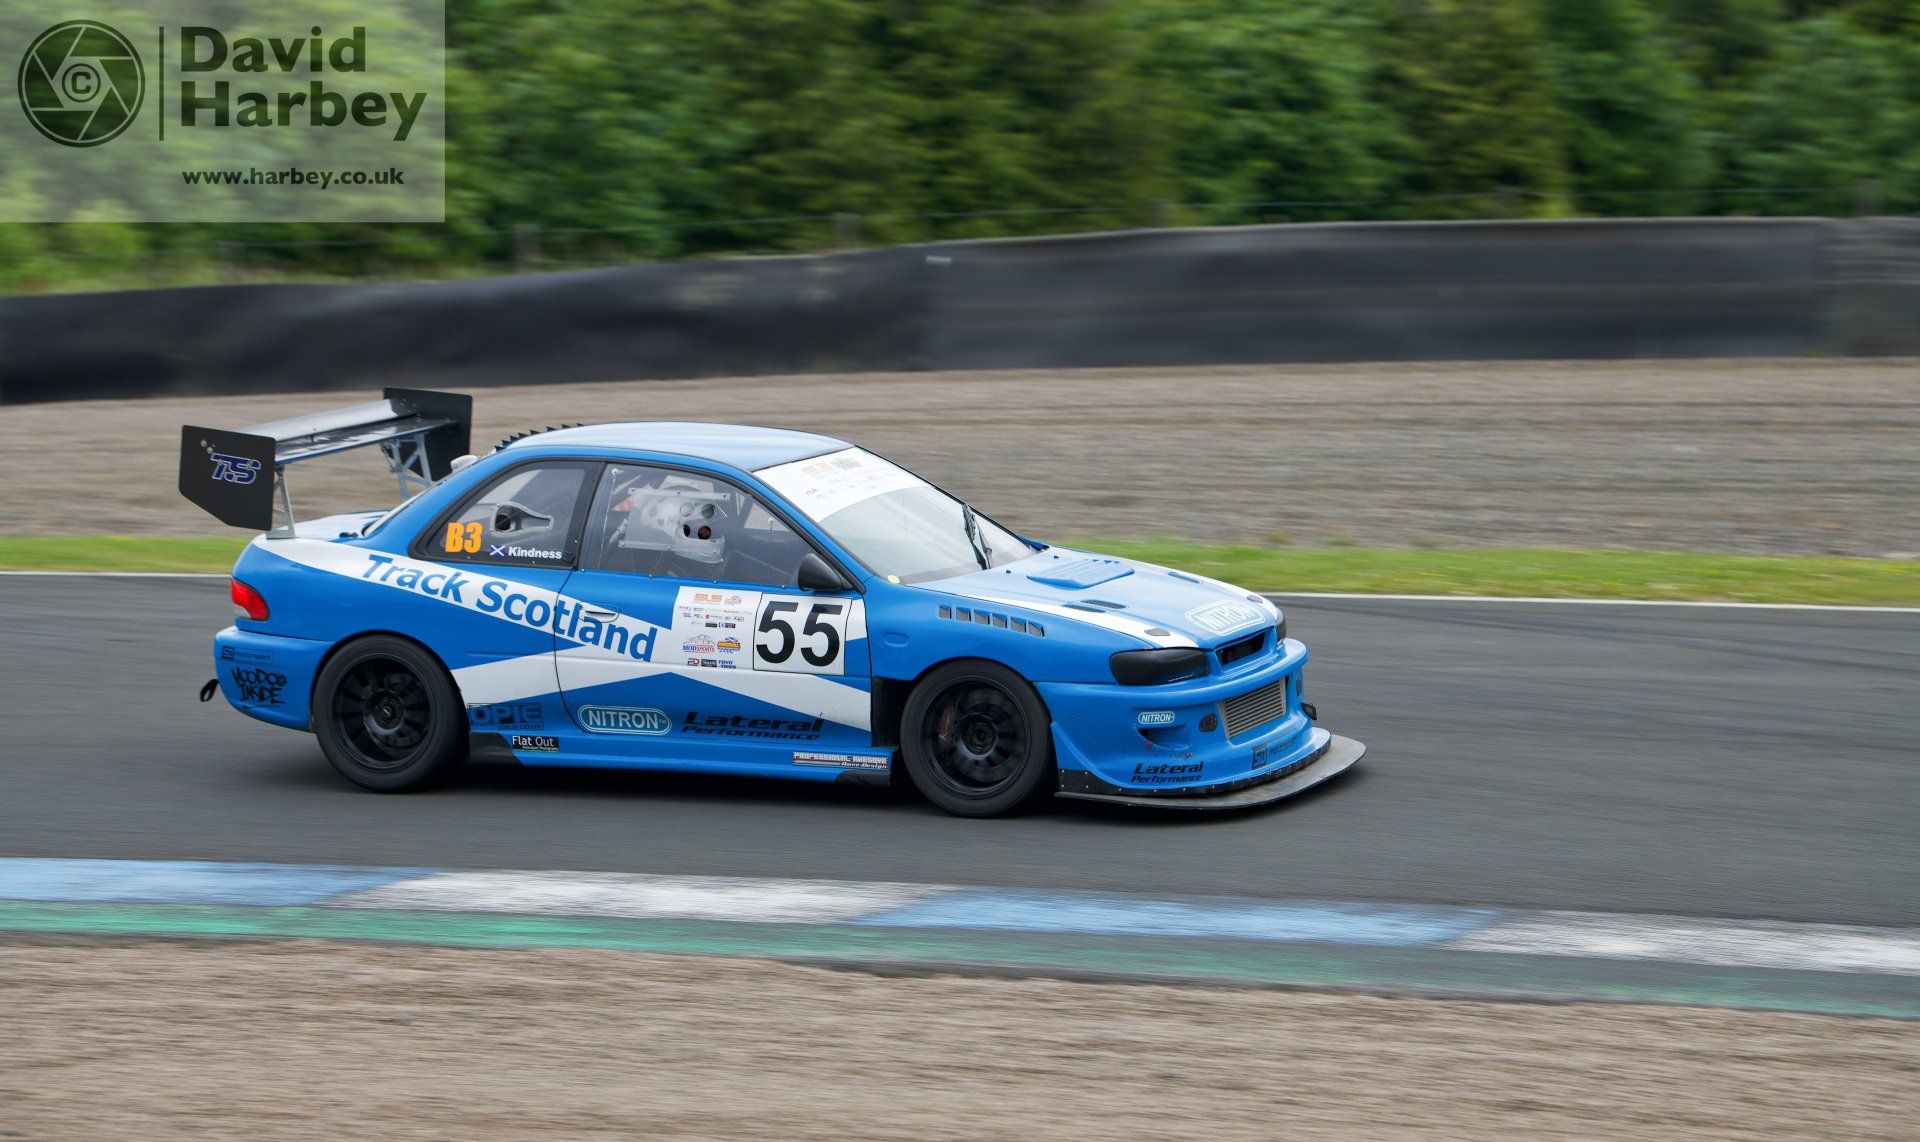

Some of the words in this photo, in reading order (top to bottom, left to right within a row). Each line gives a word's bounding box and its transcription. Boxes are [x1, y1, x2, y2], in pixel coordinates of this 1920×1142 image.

[444, 522, 483, 554] B3
[508, 546, 562, 559] Kindness
[362, 554, 470, 604] Track
[476, 581, 658, 663] Scotland
[1194, 602, 1257, 630] NITRON
[756, 600, 844, 667] 55
[231, 667, 287, 686] VOODOO
[588, 709, 659, 729] NITRON
[684, 711, 825, 732] Lateral
[1141, 714, 1171, 722] NITRON
[512, 735, 532, 746] Flat
[535, 736, 554, 747] Out
[680, 725, 820, 741] Performance
[793, 752, 852, 762] PROFESSIONAL
[861, 762, 888, 770] Design
[1133, 761, 1205, 775] Lateral
[1131, 774, 1202, 783] Performance
